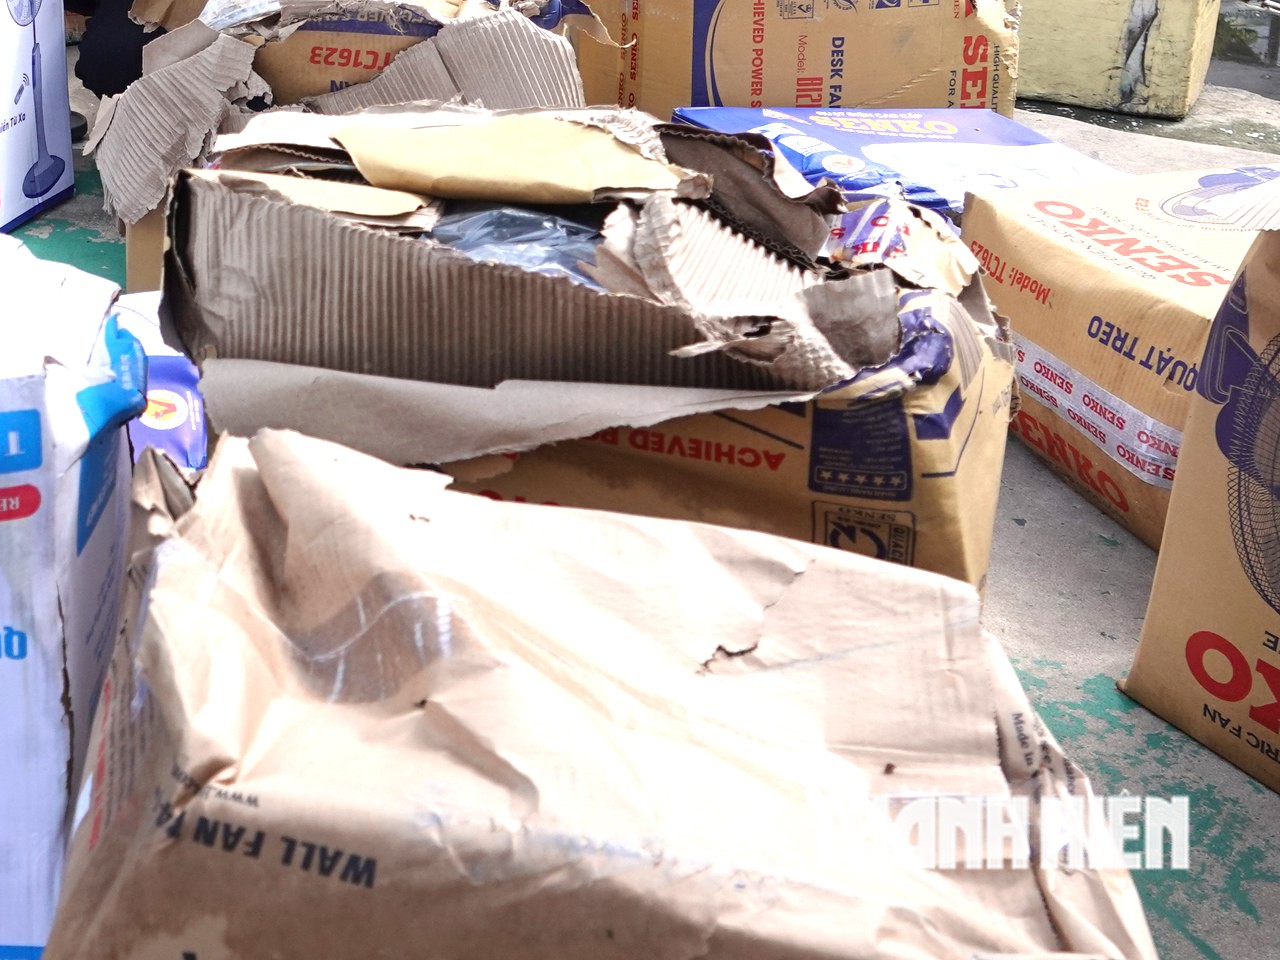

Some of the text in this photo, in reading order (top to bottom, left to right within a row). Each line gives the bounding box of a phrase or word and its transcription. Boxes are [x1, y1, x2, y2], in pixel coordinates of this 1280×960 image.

[751, 48, 764, 97] POWER
[797, 34, 808, 74] Model:
[830, 37, 845, 80] DESK
[948, 70, 957, 96] FOR
[18, 113, 26, 128] Xa
[809, 115, 958, 134] SENKO
[1033, 200, 1232, 288] SENKO
[1008, 267, 1051, 304] Model:
[1087, 315, 1198, 392] QUẠT TREO
[1033, 360, 1073, 394] SENKO
[1067, 408, 1106, 445] SENKO
[1082, 394, 1126, 431] SENKO
[628, 428, 786, 472] ACHIEVED
[1115, 443, 1176, 482] SENKO
[1012, 712, 1031, 750] Made
[1202, 703, 1242, 739] FAN
[192, 814, 378, 890] WALL FAN
